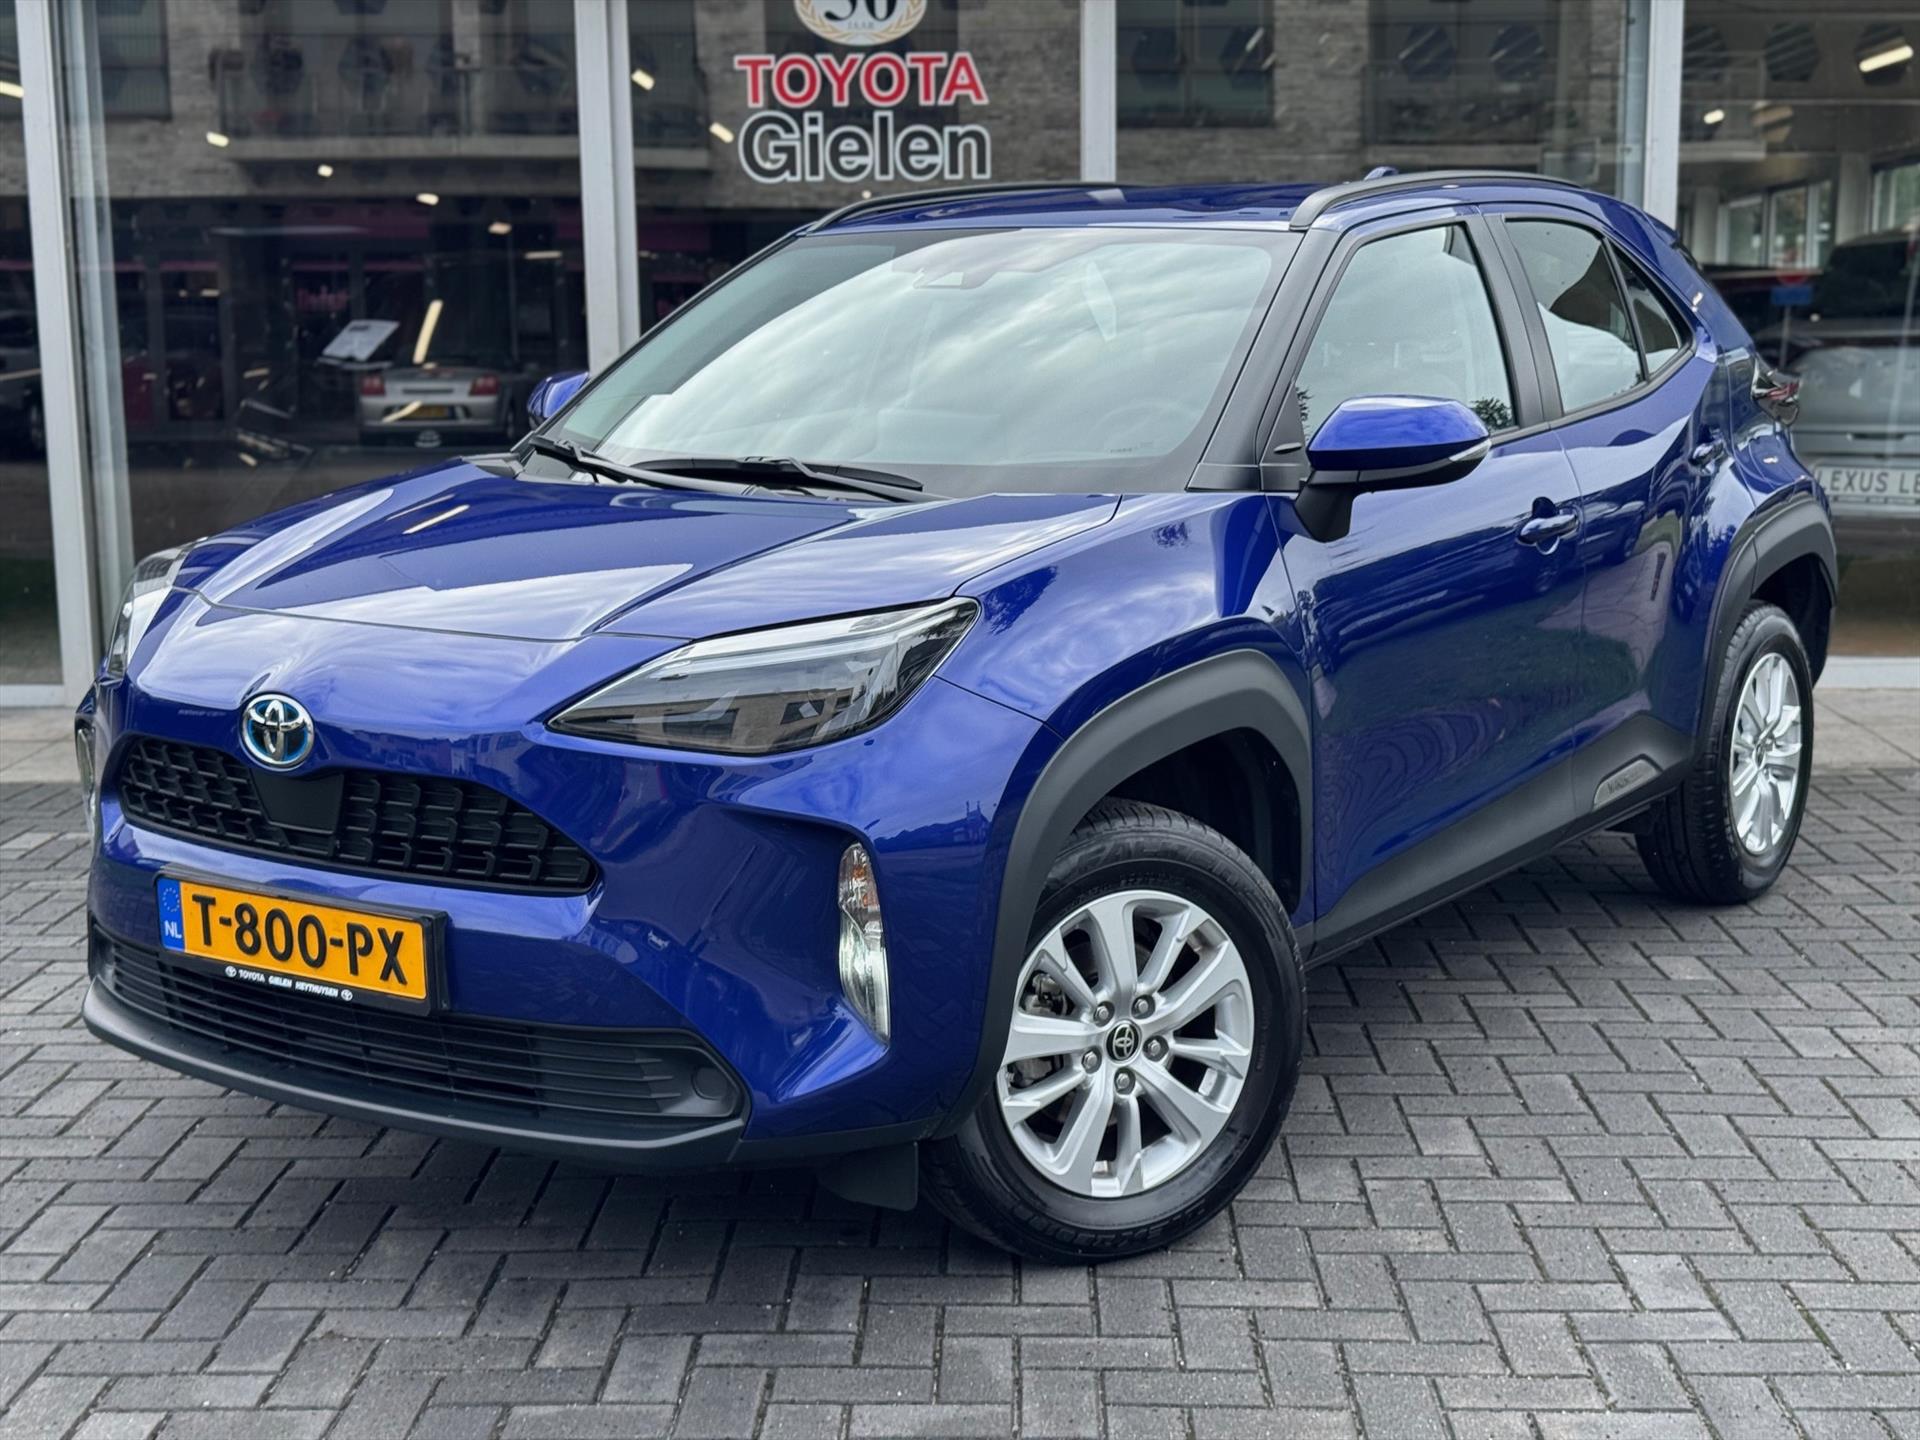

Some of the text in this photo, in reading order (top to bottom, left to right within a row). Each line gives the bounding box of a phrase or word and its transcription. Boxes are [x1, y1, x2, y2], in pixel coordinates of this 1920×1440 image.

[734, 52, 989, 108] TOYOTA
[738, 110, 992, 184] Gielen
[164, 919, 182, 939] NL
[192, 893, 408, 986] T-800-PX
[238, 969, 265, 983] TOYOTA
[268, 975, 292, 988] GIELEN
